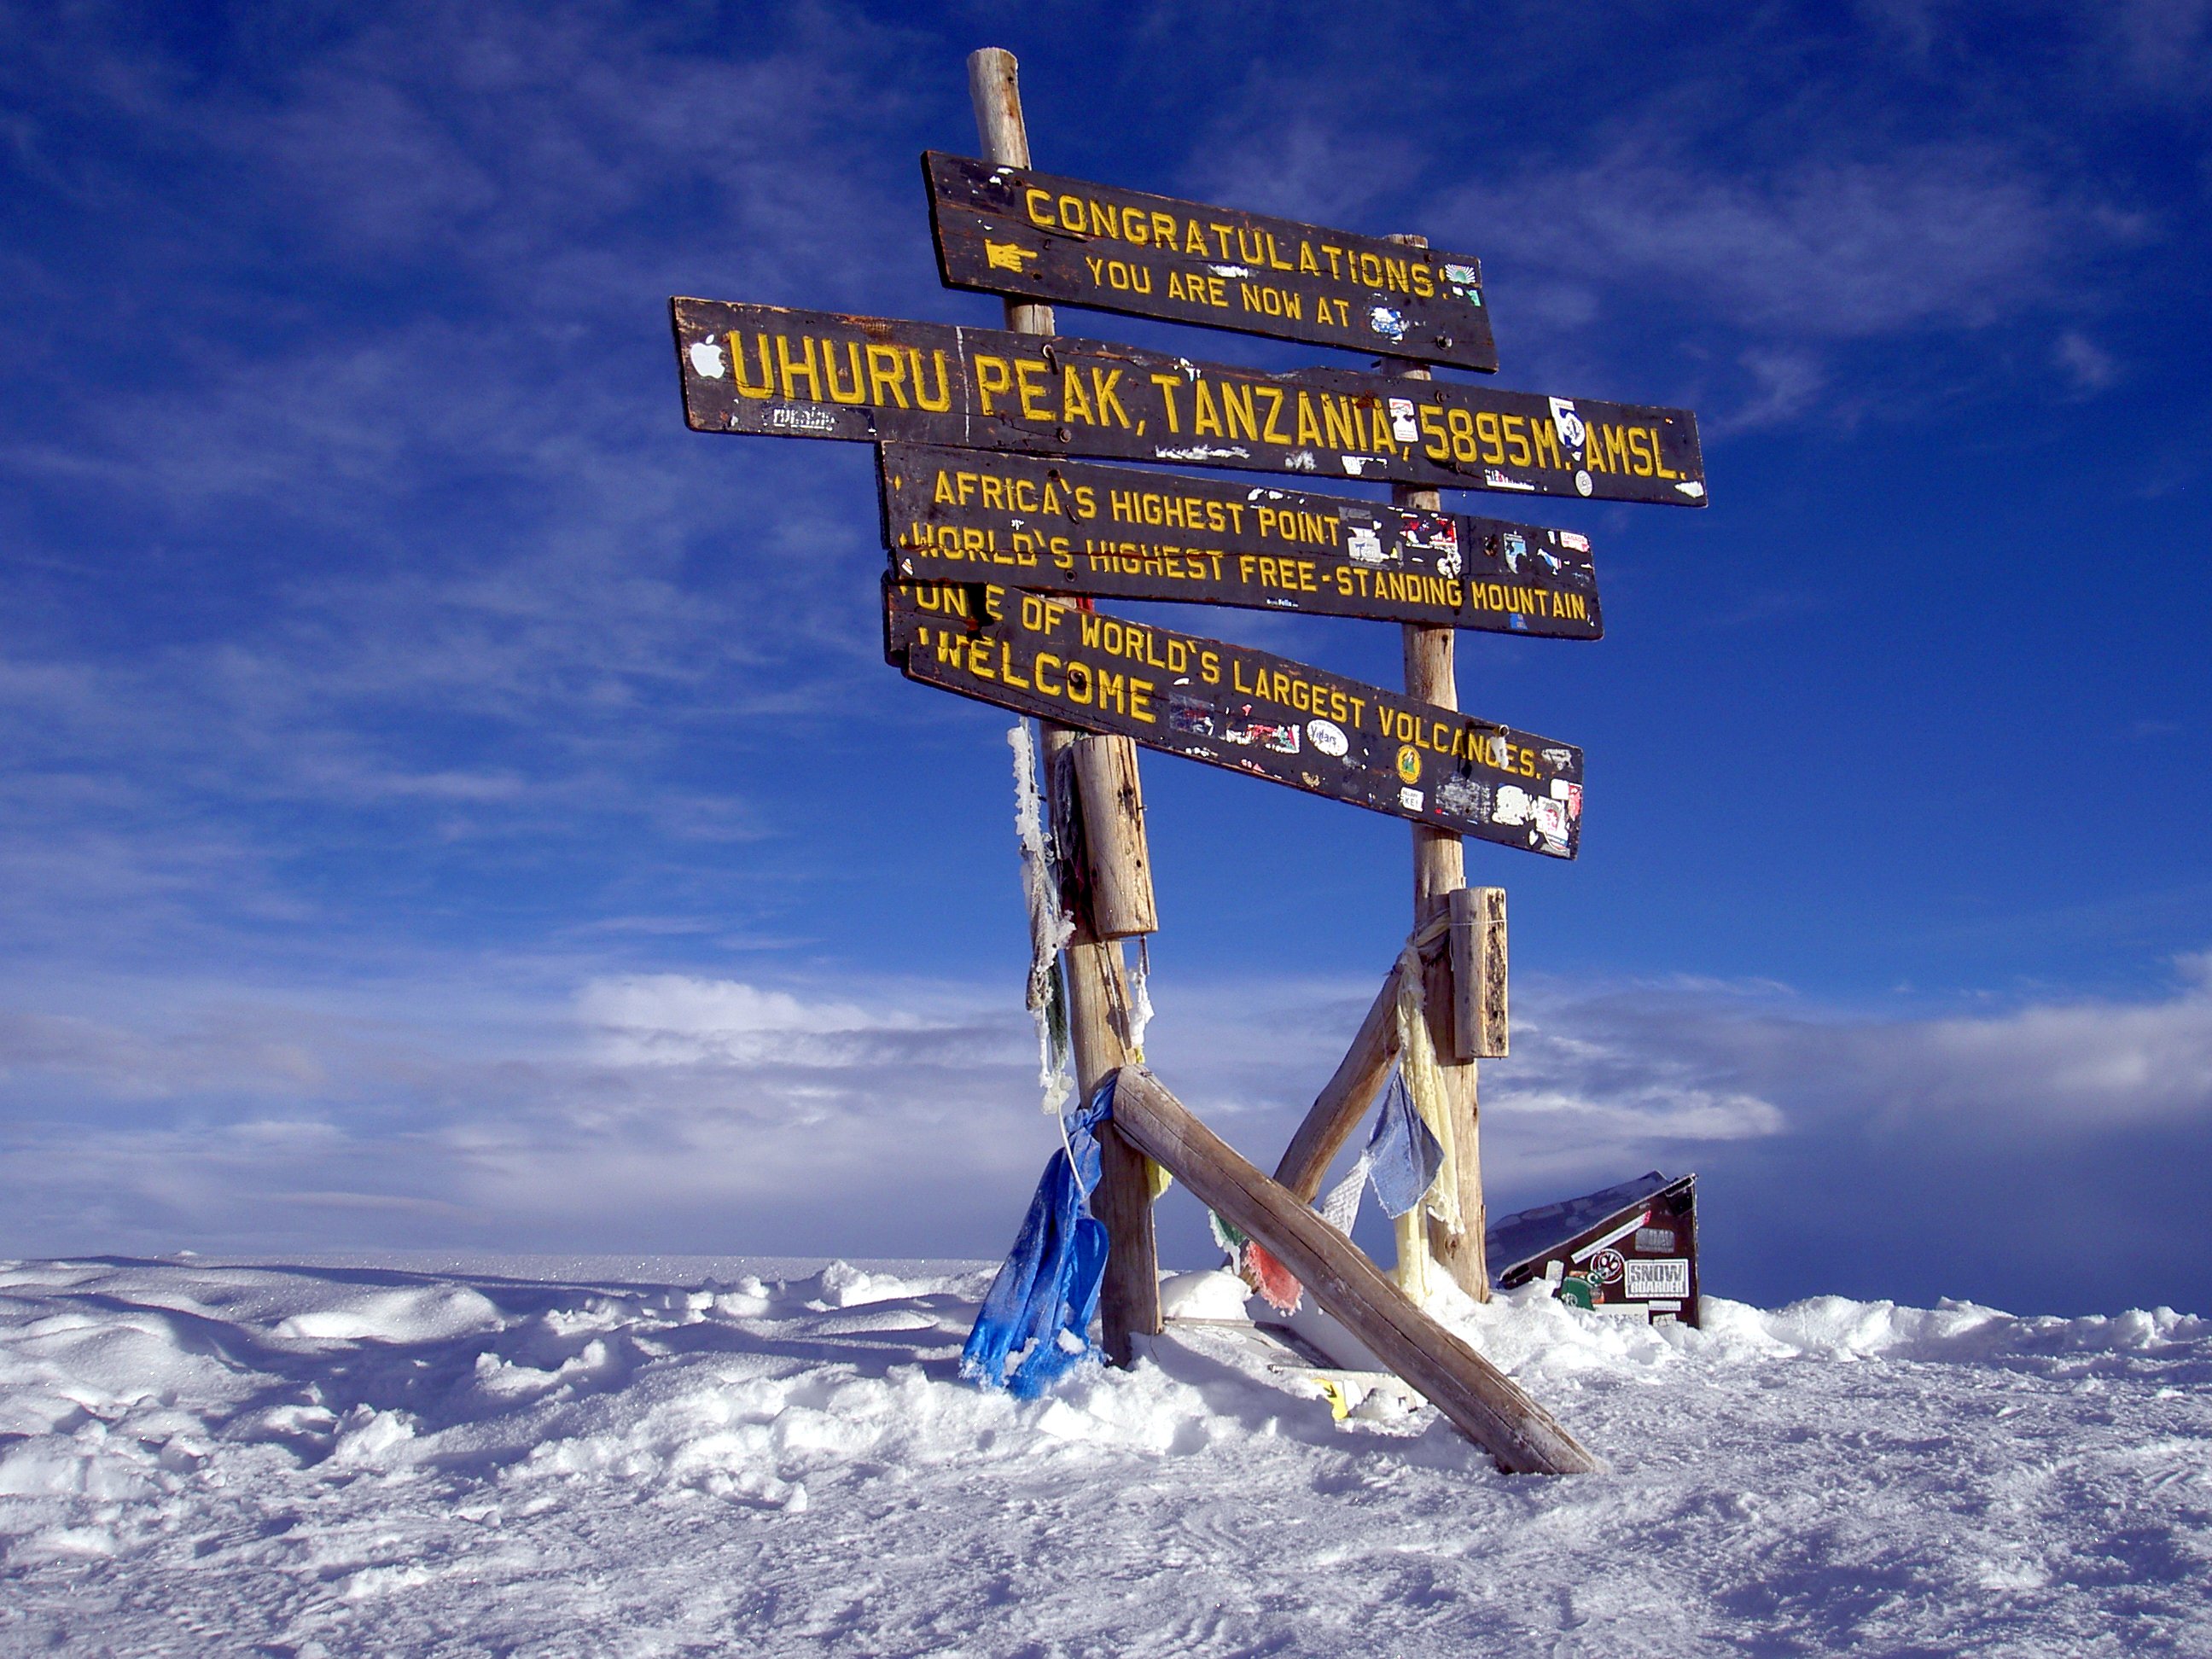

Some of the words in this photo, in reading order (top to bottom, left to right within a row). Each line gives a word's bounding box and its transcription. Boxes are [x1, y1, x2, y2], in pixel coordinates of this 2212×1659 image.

[1086, 255, 1151, 294] YOU
[1168, 271, 1230, 308] ARE
[1240, 282, 1302, 321] NOW
[1317, 296, 1350, 329] AT
[727, 329, 952, 413] UHURU
[974, 353, 1146, 437] PEAK,
[1585, 421, 1686, 480] AMSL.
[934, 469, 1097, 519] AFRICA'S
[1109, 489, 1244, 535] HIGHEST
[1257, 507, 1341, 547] POINT
[1086, 538, 1225, 581] HIGHEST
[1238, 554, 1463, 607] FREE-STANDING
[1470, 580, 1587, 620] MOUNTAIN
[937, 629, 1156, 725] WELCOME
[1022, 595, 1066, 636] OF
[1080, 612, 1220, 684] WORLD'S
[1233, 660, 1366, 729] LARGEST
[1630, 1264, 1683, 1282] SNOW
